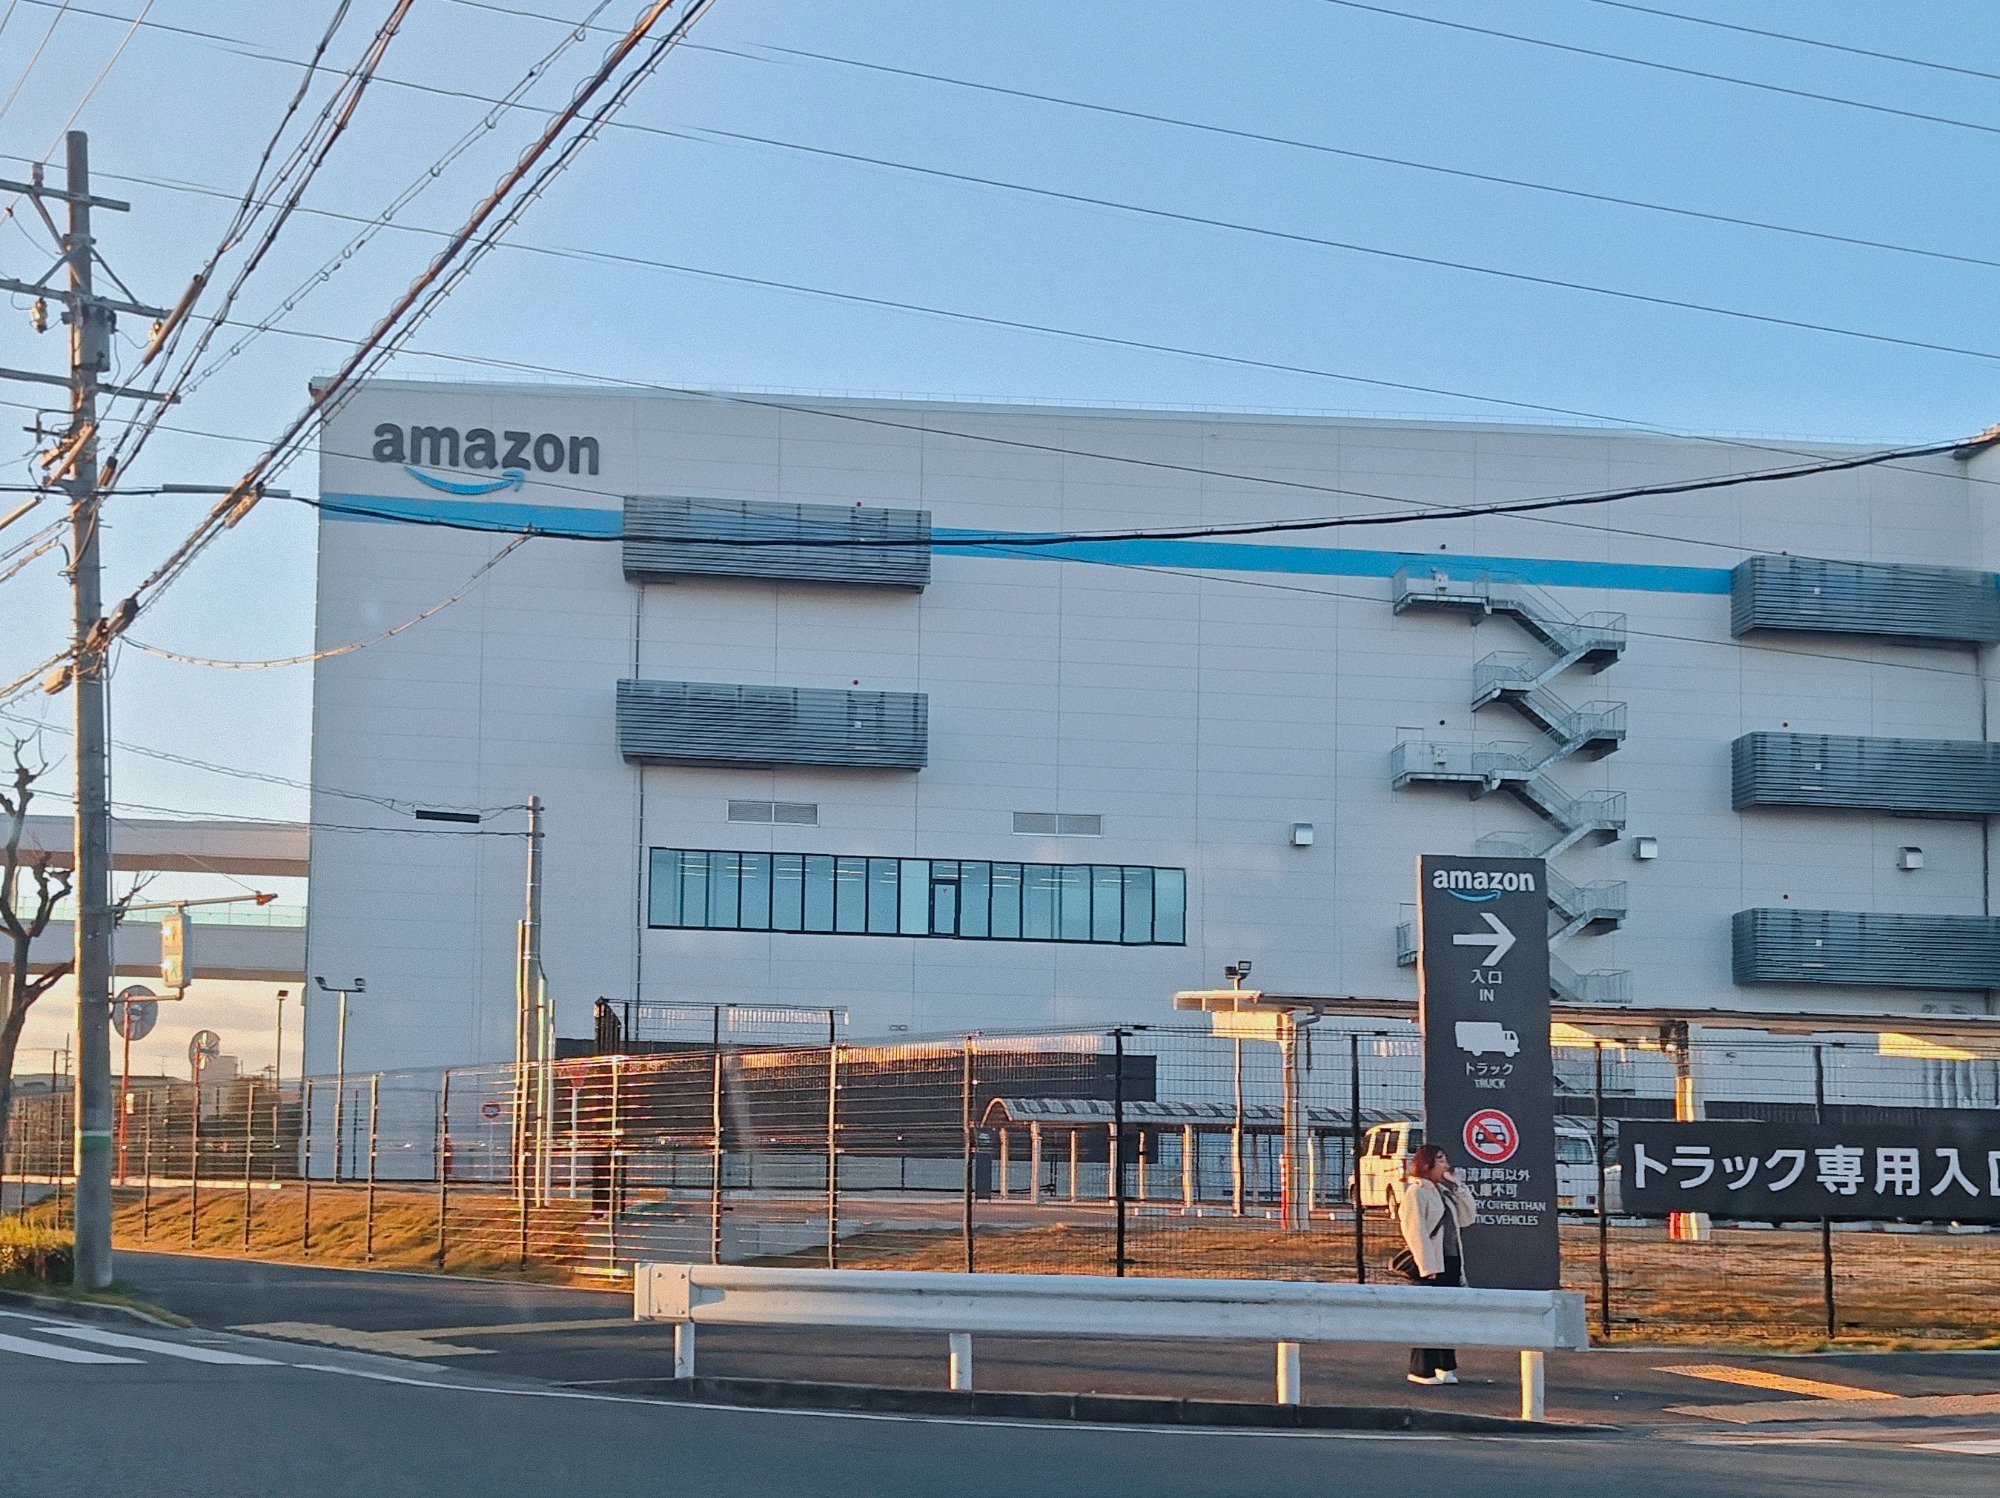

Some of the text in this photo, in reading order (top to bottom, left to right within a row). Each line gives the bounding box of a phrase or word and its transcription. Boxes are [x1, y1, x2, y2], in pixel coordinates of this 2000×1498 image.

[372, 423, 599, 476] amazon
[1432, 869, 1536, 892] amazon
[1470, 969, 1503, 985] 入口
[1479, 988, 1495, 1002] IN
[1465, 1062, 1514, 1076] トラック
[1473, 1078, 1506, 1090] TRUCK
[1633, 1143, 2000, 1198] トラック専用入
[1520, 1201, 1546, 1212] THAN
[1495, 1214, 1539, 1226] VEHICLES
